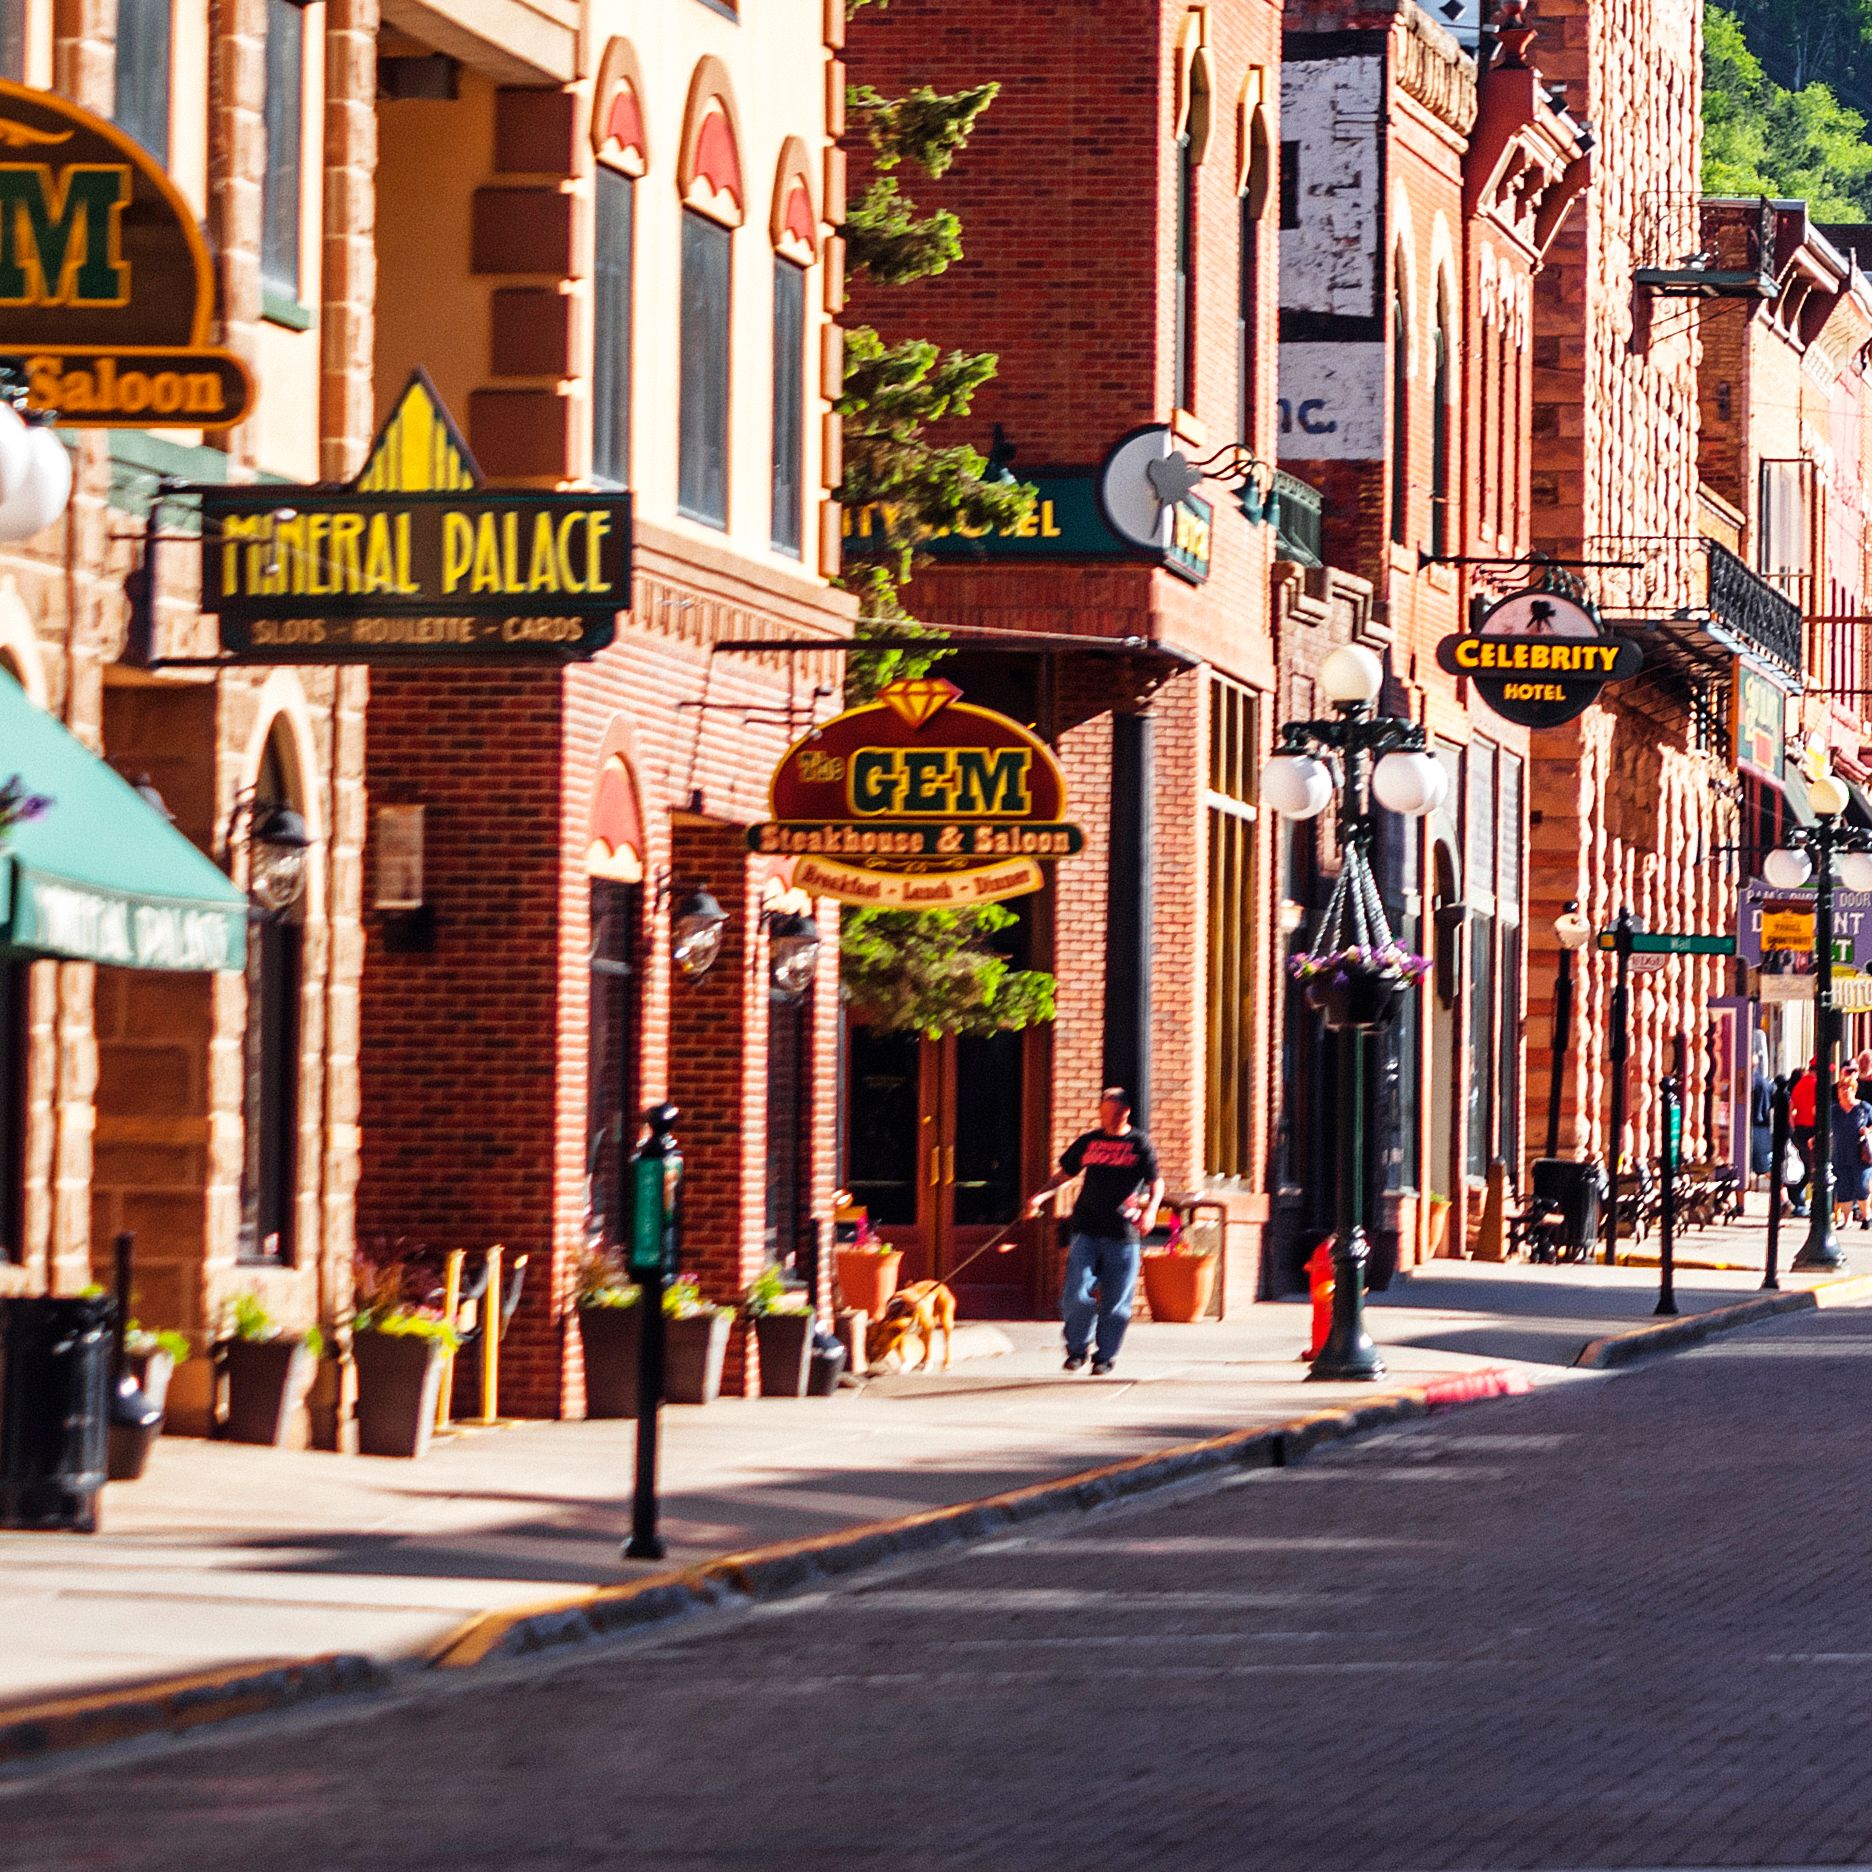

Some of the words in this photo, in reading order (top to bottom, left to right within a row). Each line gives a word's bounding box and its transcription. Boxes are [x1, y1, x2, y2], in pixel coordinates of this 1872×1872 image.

[25, 356, 225, 413] Saloon
[222, 511, 420, 597] MINERAL
[441, 510, 611, 595] PALACE
[251, 618, 327, 645] SLOTS
[502, 616, 585, 642] CARDS
[1455, 639, 1620, 671] CELEBRITY
[1504, 683, 1566, 701] HOTEL
[852, 746, 1032, 816] GEM
[759, 825, 925, 854] Steakhouse
[937, 826, 965, 853] &
[974, 826, 1071, 854] Saloon
[1840, 892, 1870, 908] DOOR
